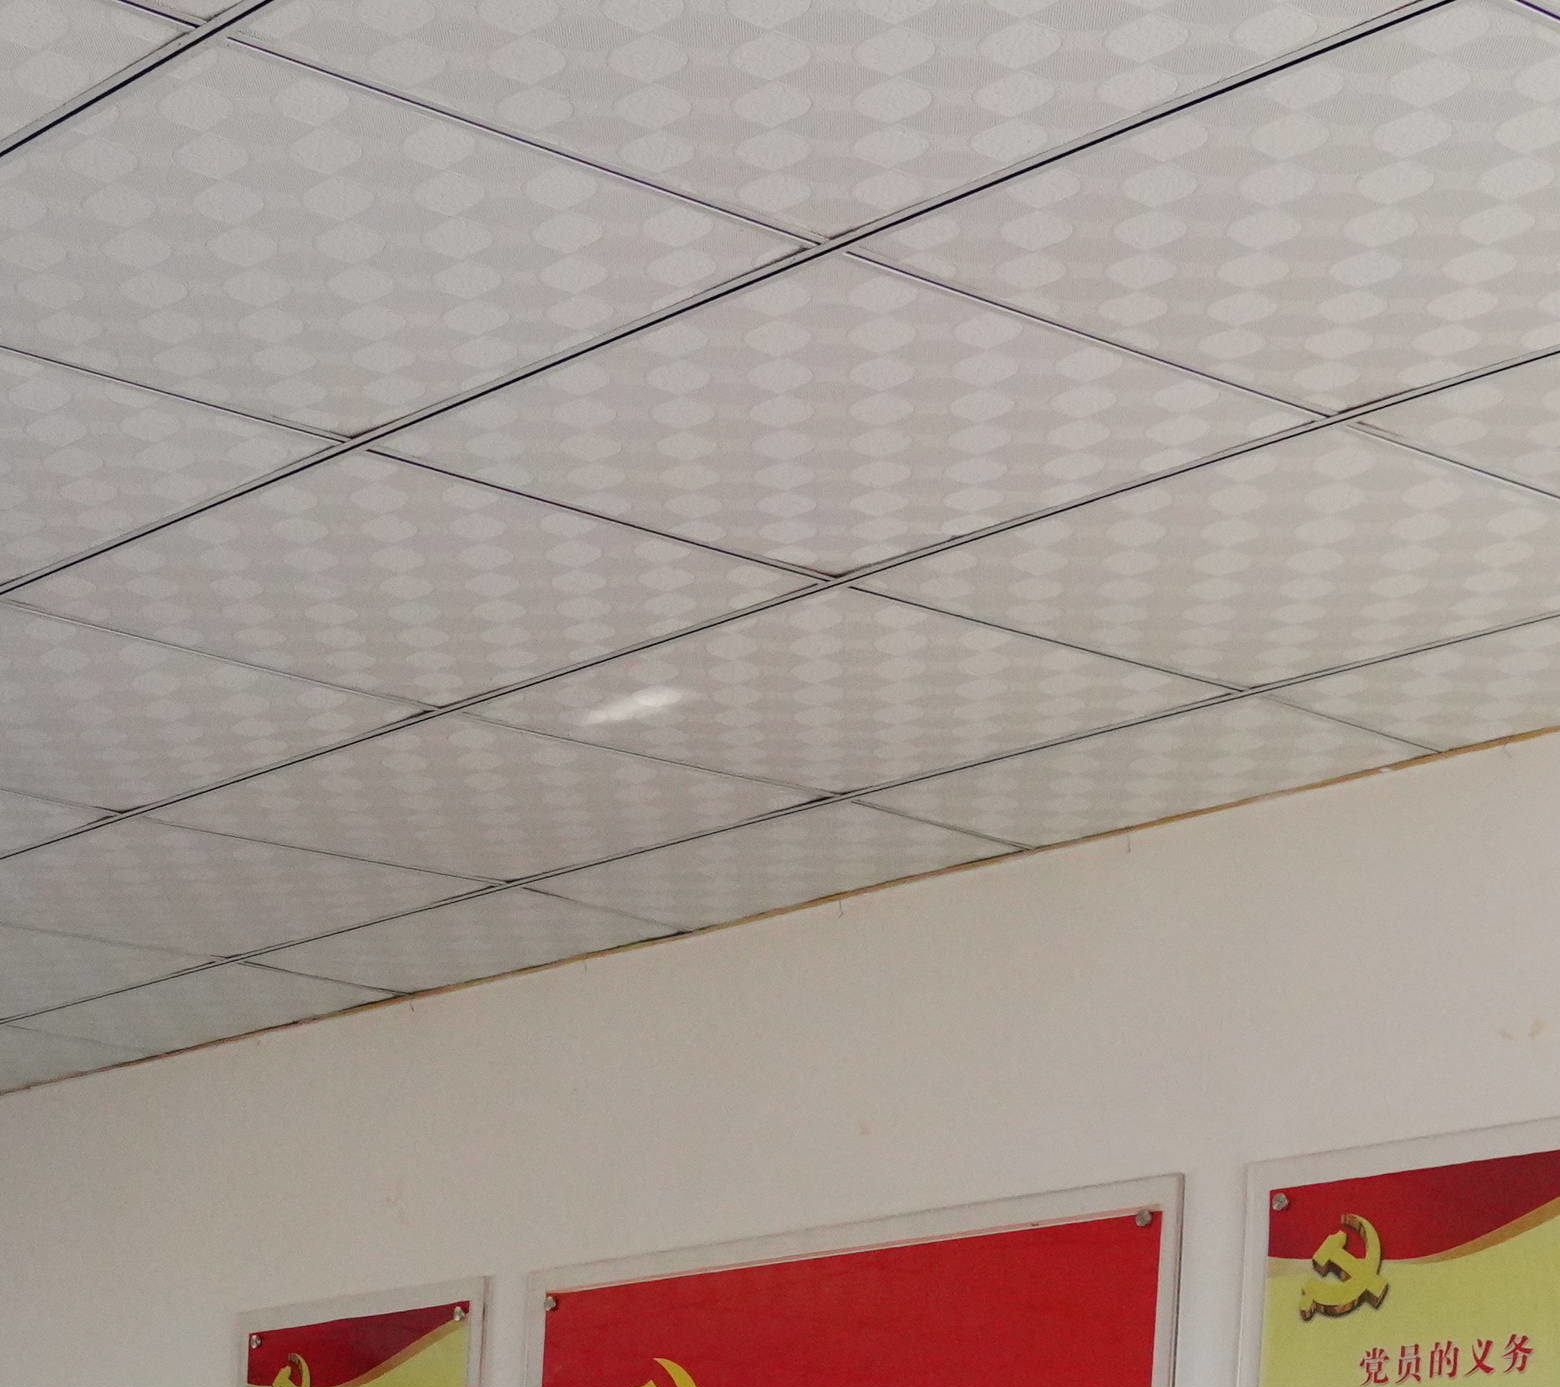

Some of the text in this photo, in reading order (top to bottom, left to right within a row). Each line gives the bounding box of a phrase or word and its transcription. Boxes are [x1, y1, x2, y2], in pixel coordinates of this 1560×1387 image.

[1359, 1333, 1535, 1386] 党员的义务
